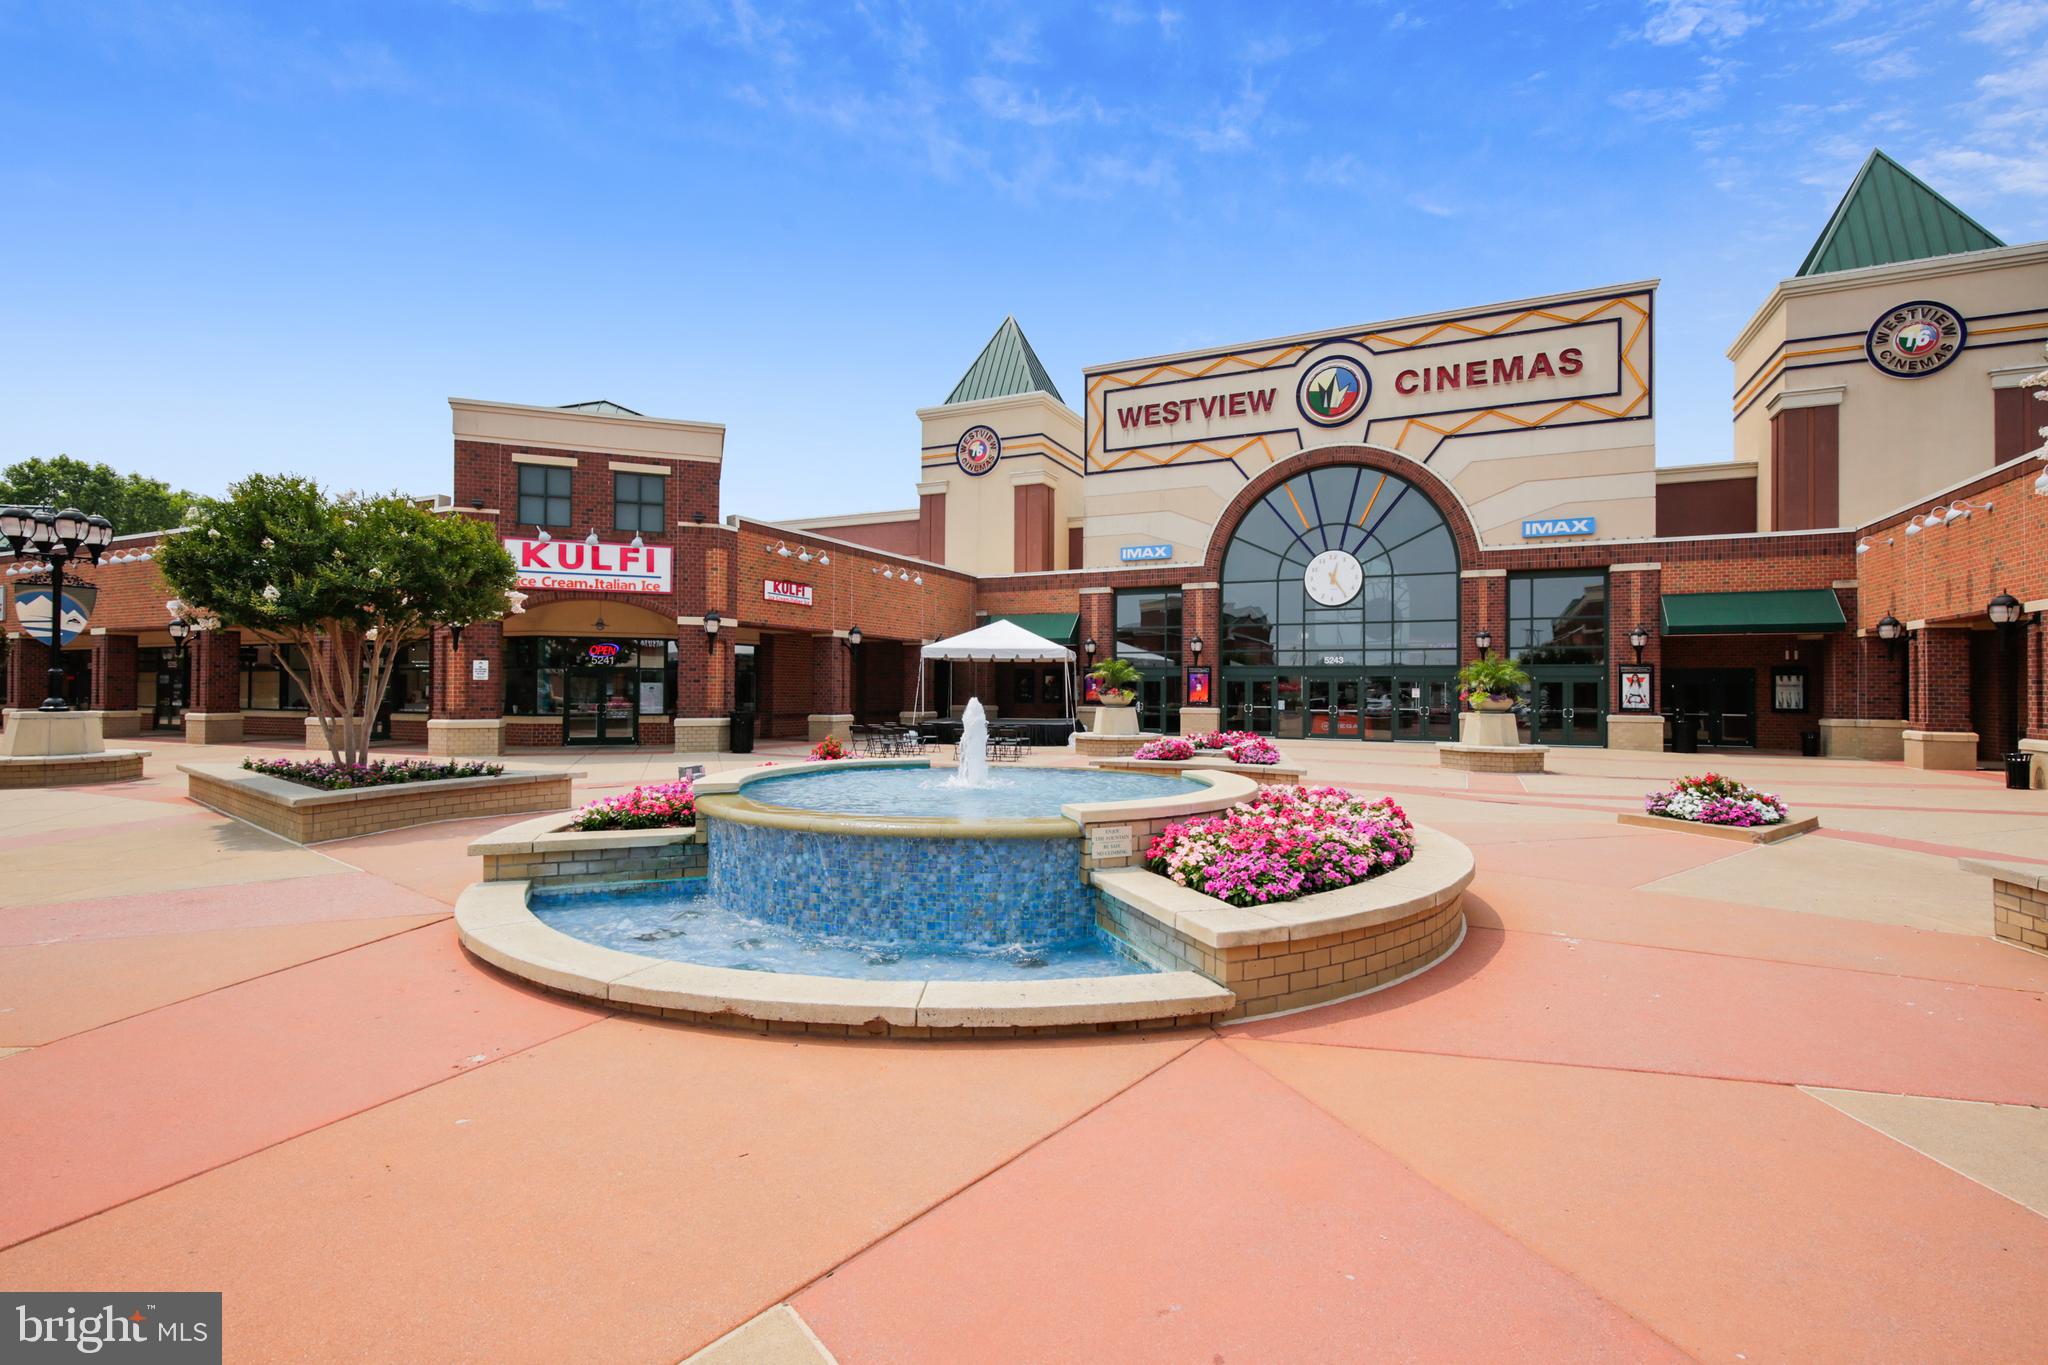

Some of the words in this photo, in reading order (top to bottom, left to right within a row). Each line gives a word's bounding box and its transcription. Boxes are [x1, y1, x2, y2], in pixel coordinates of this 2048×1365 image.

[1876, 308, 1957, 345] WESTVIEW
[1905, 329, 1930, 348] 16
[1880, 343, 1954, 370] CINEMAS
[1117, 388, 1277, 429] WESTVIEW
[1395, 347, 1584, 394] CINEMAS
[960, 430, 997, 453] WESTVIEW
[962, 455, 995, 472] CINEMAS
[1525, 519, 1589, 535] IMAX
[522, 542, 655, 572] KULFI
[1122, 546, 1167, 559] IMAX
[641, 580, 661, 591] Ice
[773, 580, 805, 597] KULFI
[590, 645, 616, 655] OPEN
[591, 656, 615, 665] 5241
[1324, 656, 1344, 664] 5243
